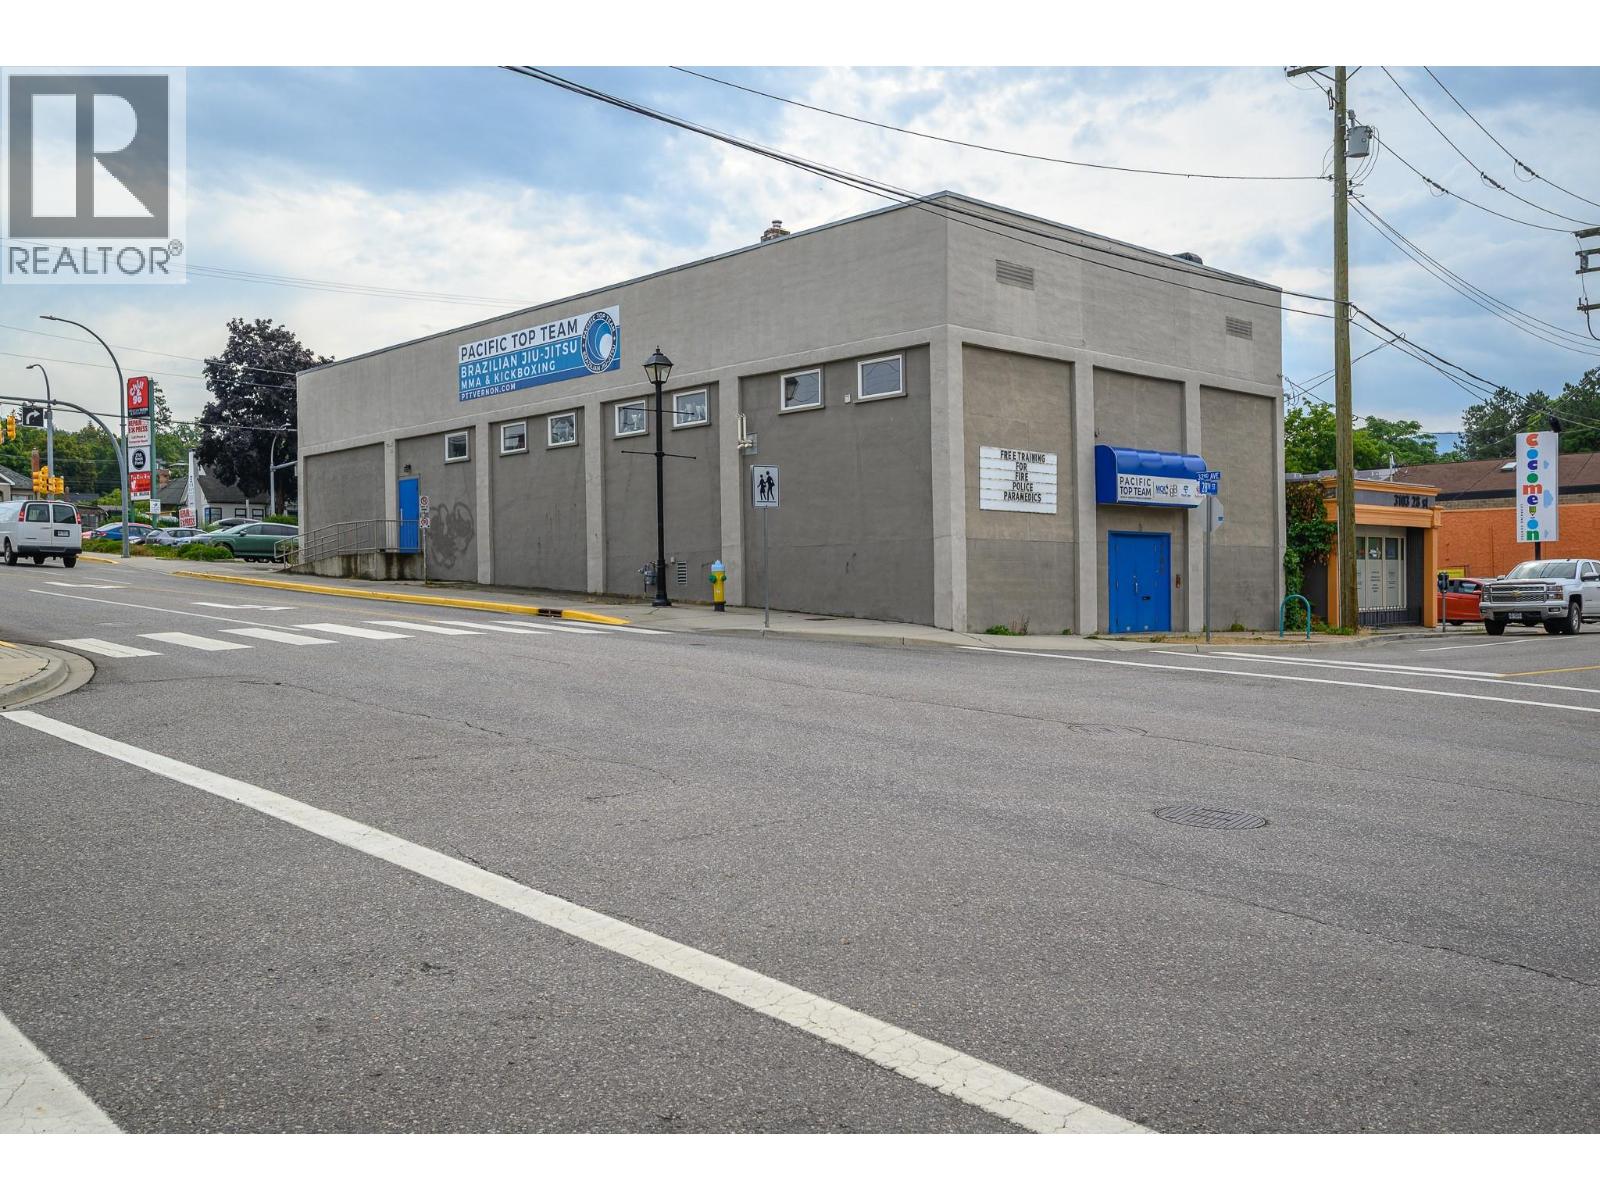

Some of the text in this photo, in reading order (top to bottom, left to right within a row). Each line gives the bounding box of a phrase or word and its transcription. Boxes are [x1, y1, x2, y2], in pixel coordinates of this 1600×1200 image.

[461, 319, 578, 360] PACIFIC TOP TEAM
[461, 340, 578, 378] BRAZILIAN JIU-JITSU
[461, 360, 556, 390] MMA & KICKBOXING
[461, 382, 516, 400] PTTVERNON.COM
[1000, 450, 1046, 463] FREE TRAINING
[1015, 462, 1028, 471] FOR
[1015, 471, 1029, 481] FIRE
[1119, 476, 1151, 487] PACIFIC
[1012, 482, 1034, 492] POLICE
[1119, 486, 1132, 495] TOP
[1133, 487, 1152, 496] TEAM
[1003, 491, 1042, 503] PARAMEDICS
